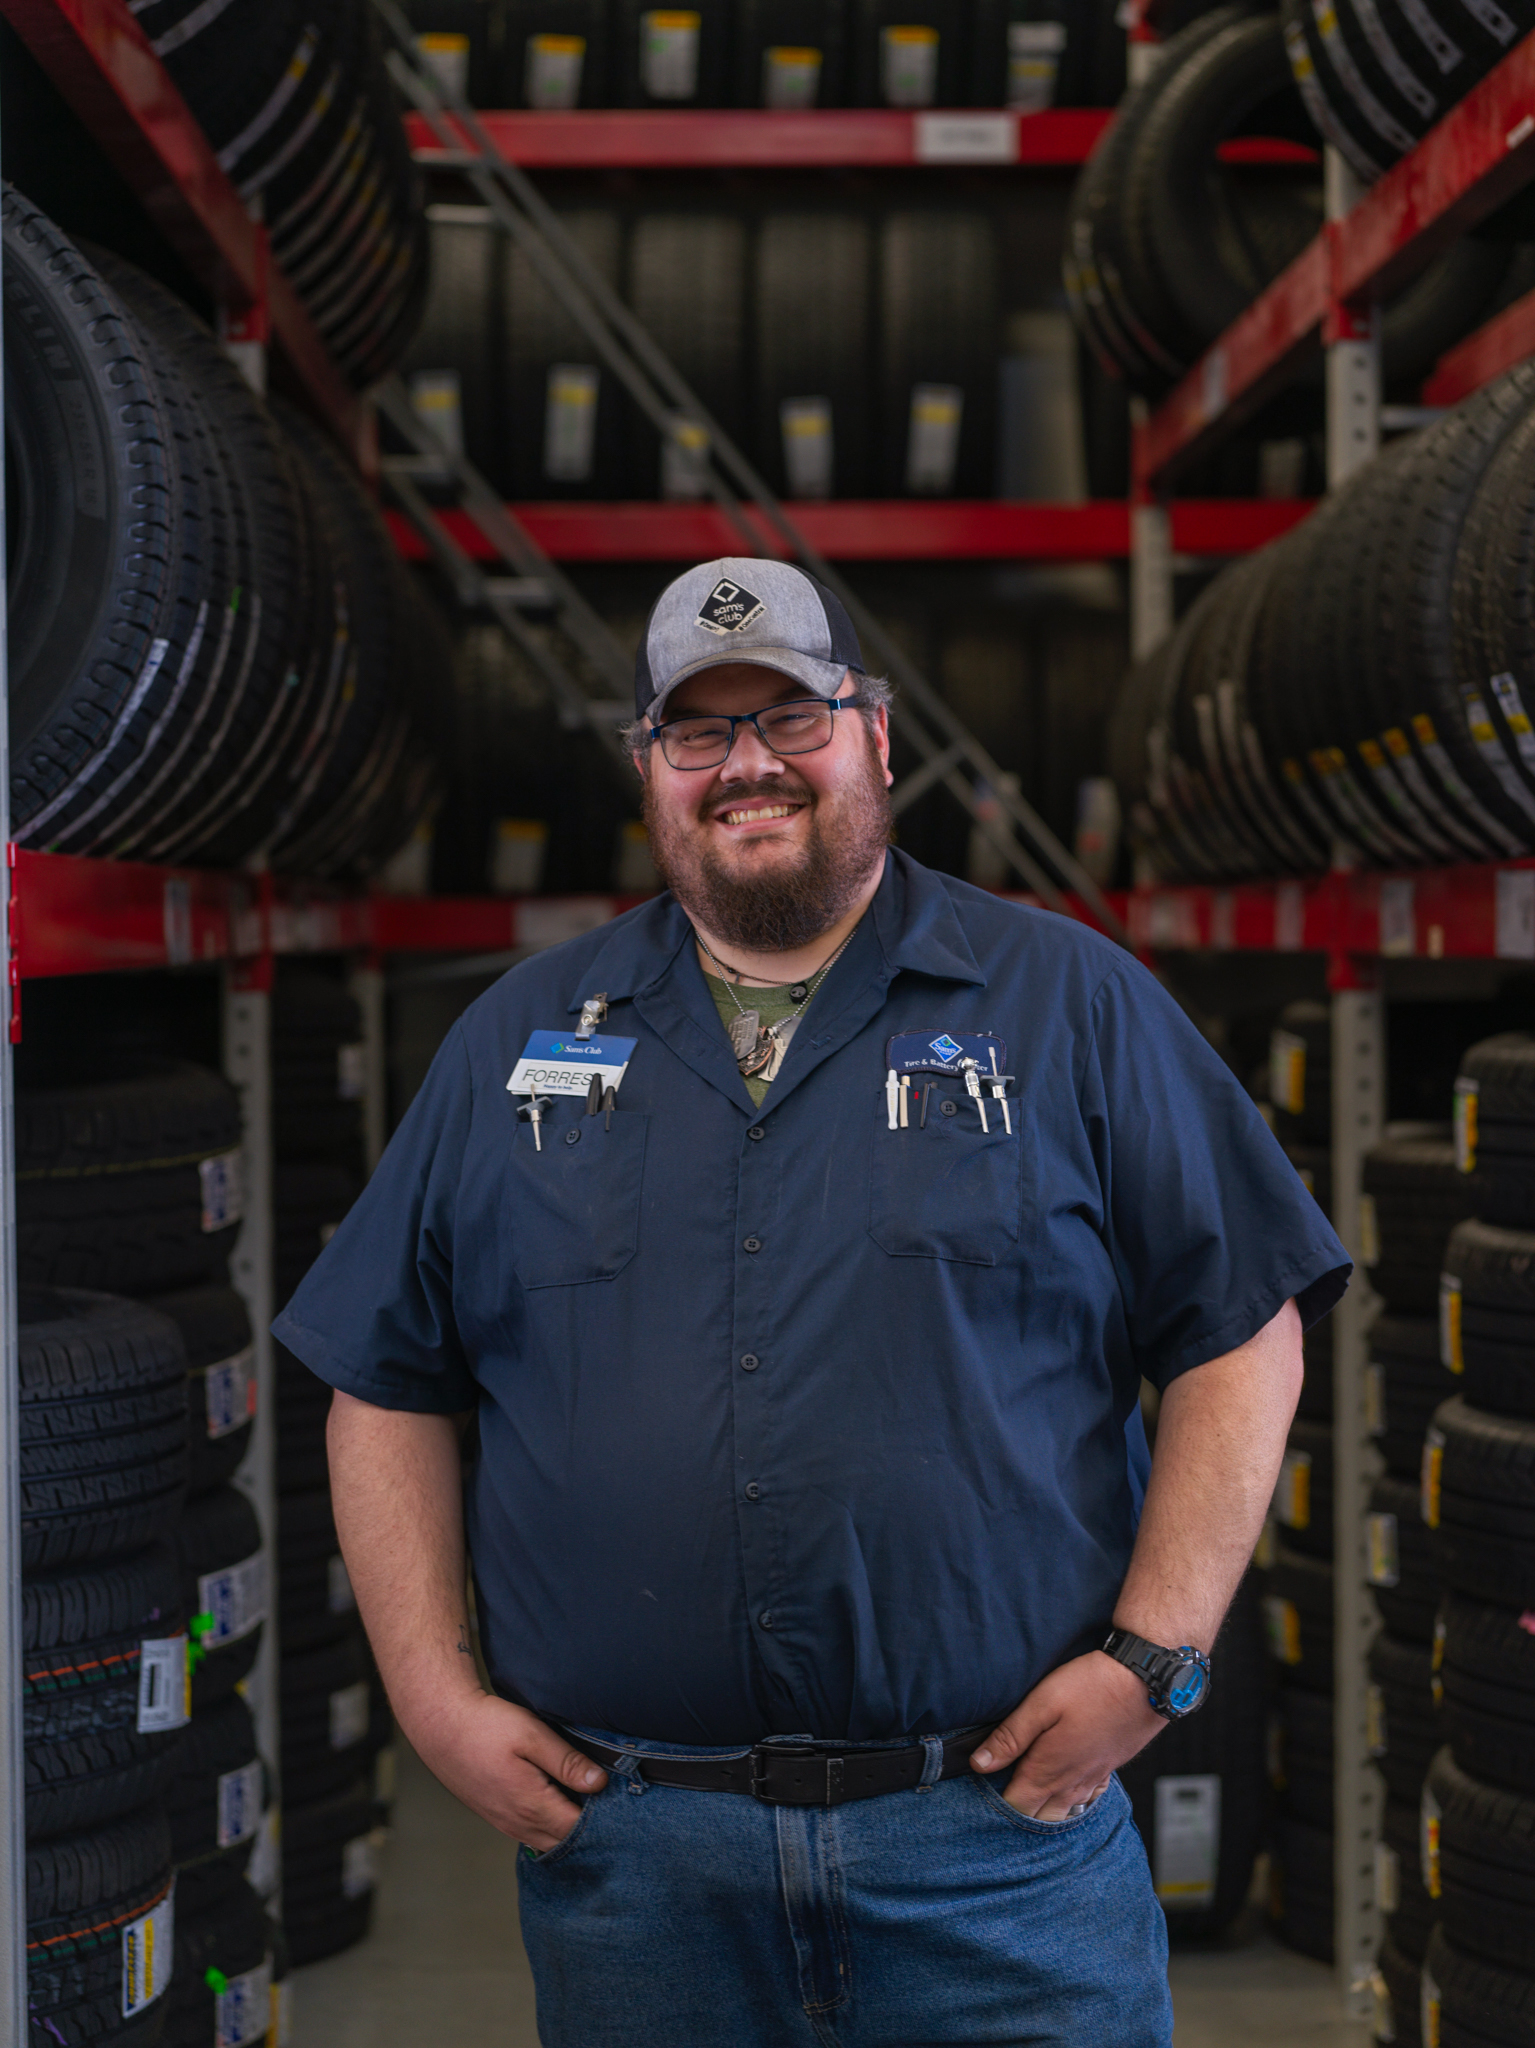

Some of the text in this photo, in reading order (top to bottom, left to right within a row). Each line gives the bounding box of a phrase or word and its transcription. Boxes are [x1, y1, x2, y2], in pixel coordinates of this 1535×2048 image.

[713, 603, 745, 617] sam's
[718, 612, 743, 624] club
[584, 1046, 602, 1055] Club
[930, 1058, 959, 1072] Battery
